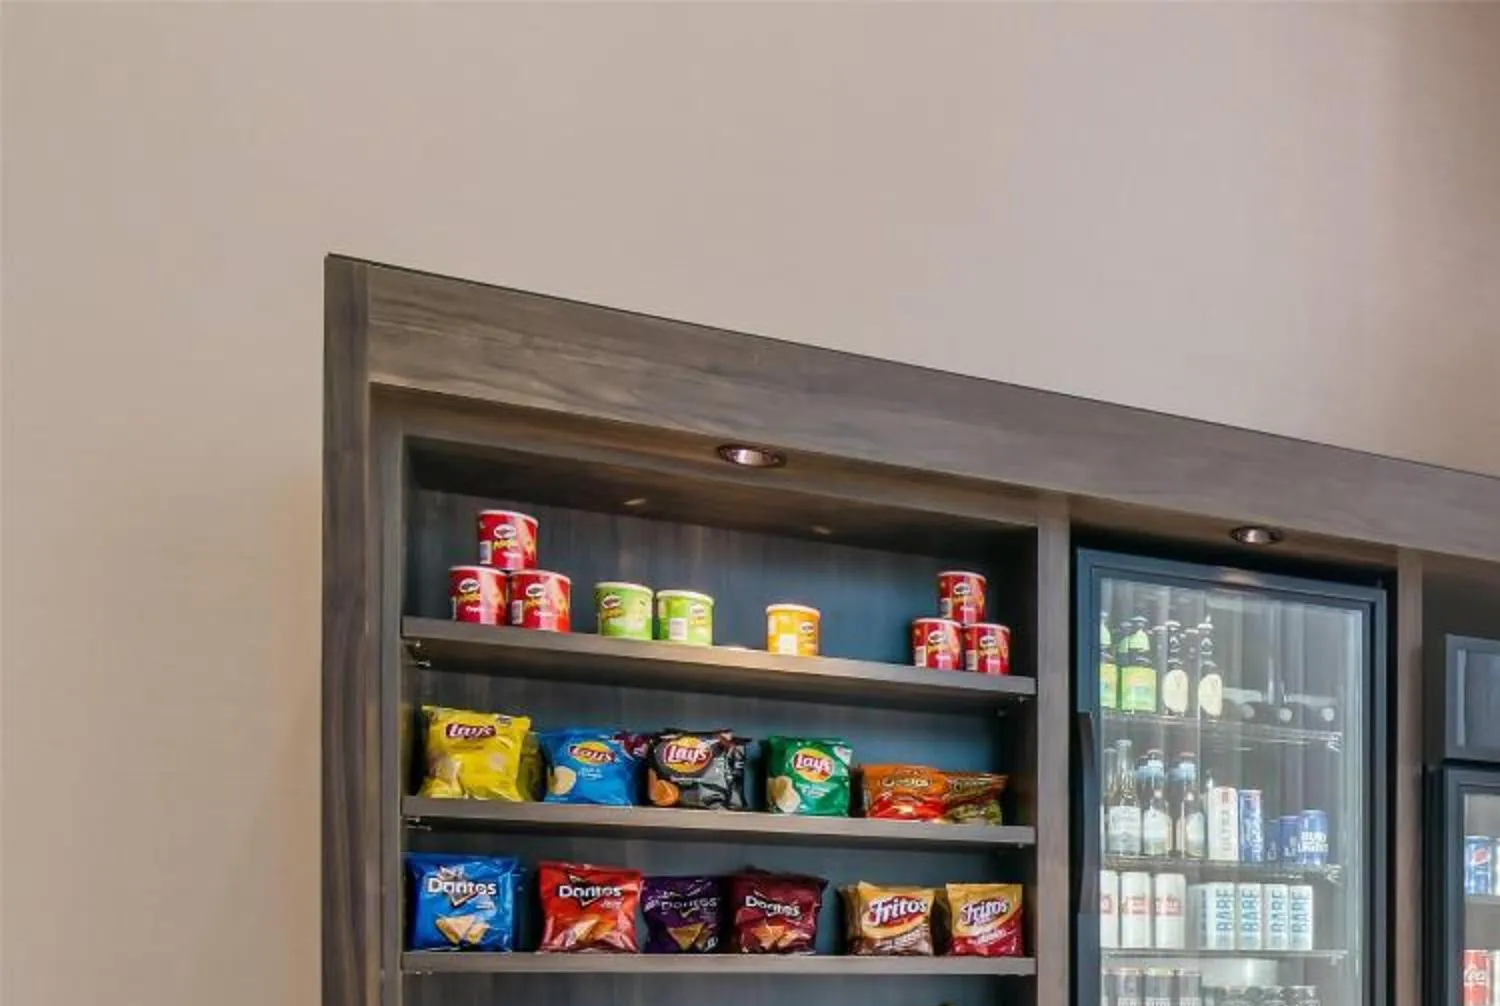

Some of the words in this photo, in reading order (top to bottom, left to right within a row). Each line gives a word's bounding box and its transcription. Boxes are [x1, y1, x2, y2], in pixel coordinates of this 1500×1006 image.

[427, 877, 497, 896] Doritos
[558, 885, 624, 898] Doritos
[745, 895, 801, 917] Doritos
[868, 896, 929, 928] Fritos
[960, 898, 1009, 925] Fritos
